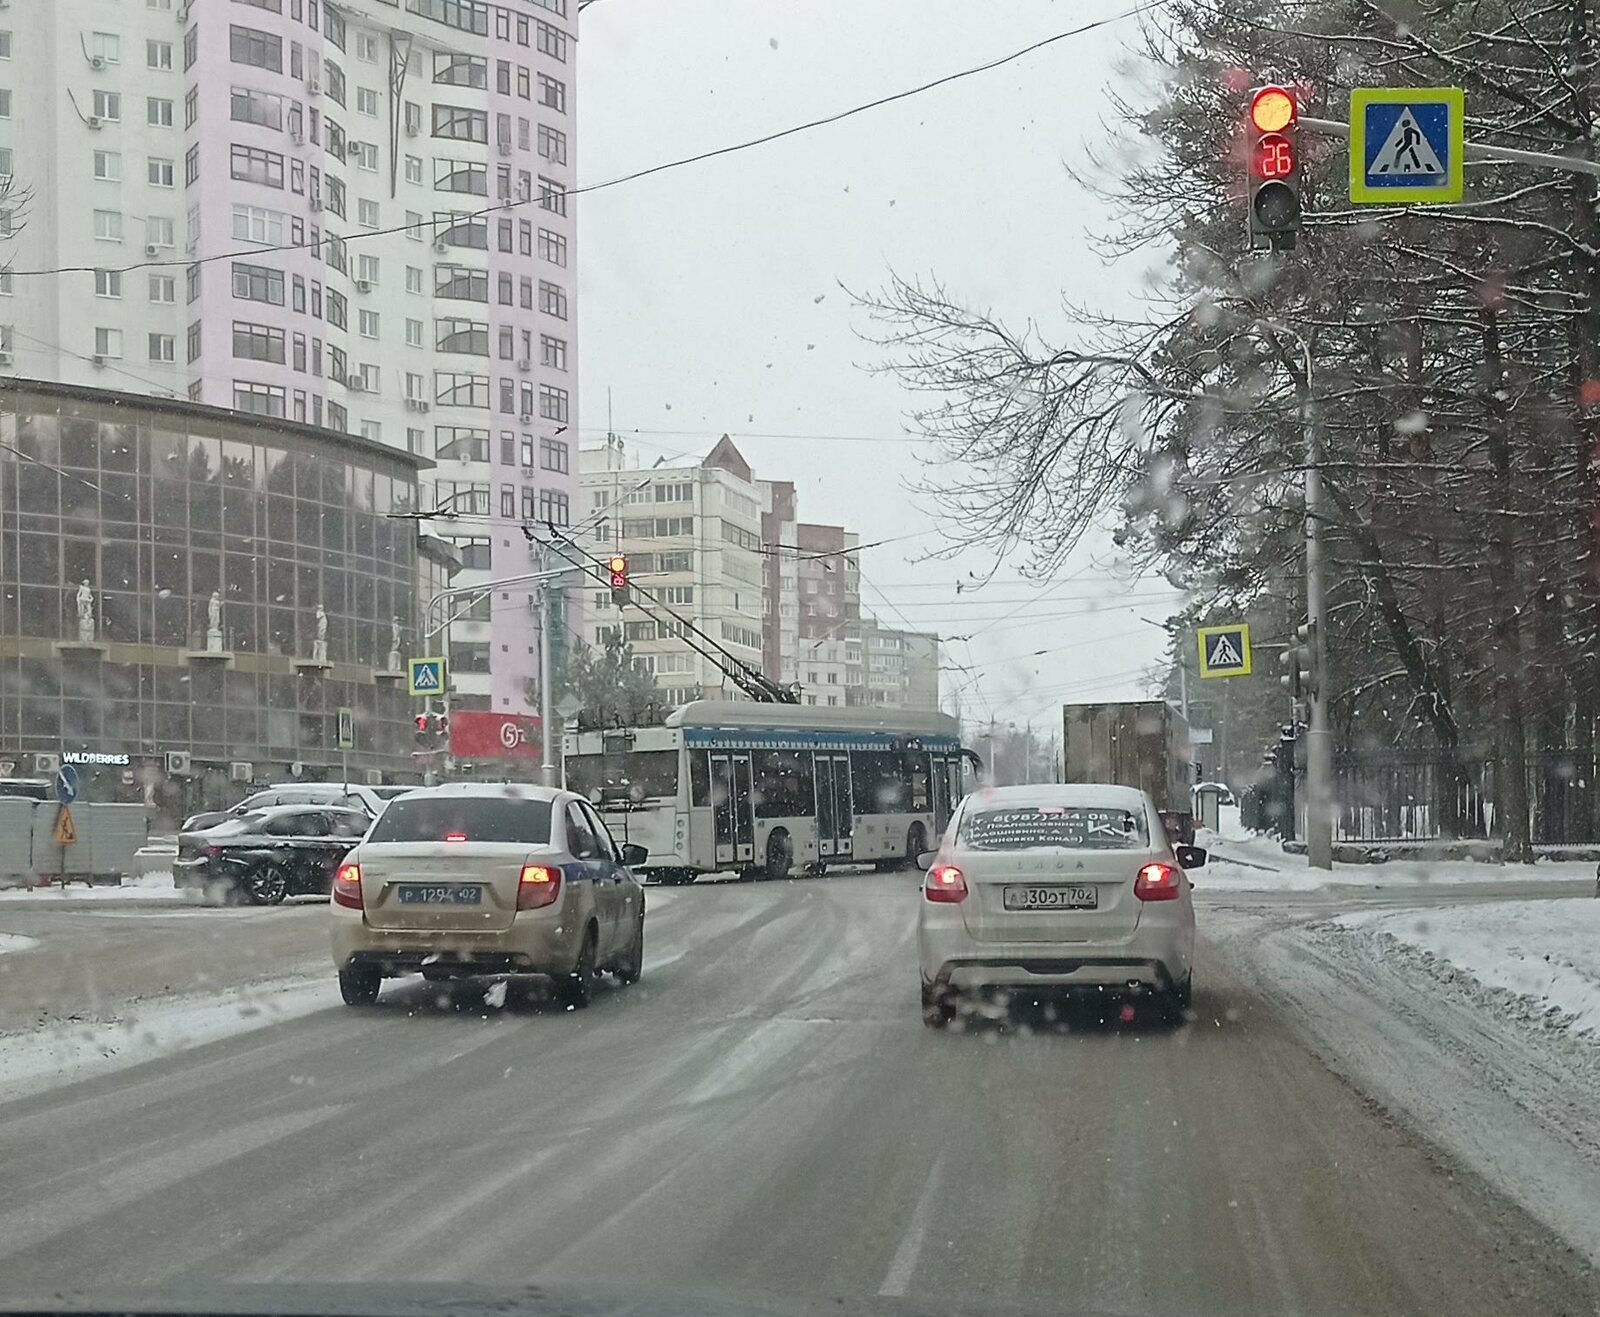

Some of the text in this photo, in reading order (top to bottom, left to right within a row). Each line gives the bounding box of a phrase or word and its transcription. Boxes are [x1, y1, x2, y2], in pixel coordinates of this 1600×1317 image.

[1262, 140, 1292, 176] 26
[62, 752, 130, 765] WILDBERRIES
[420, 888, 454, 902] 1294
